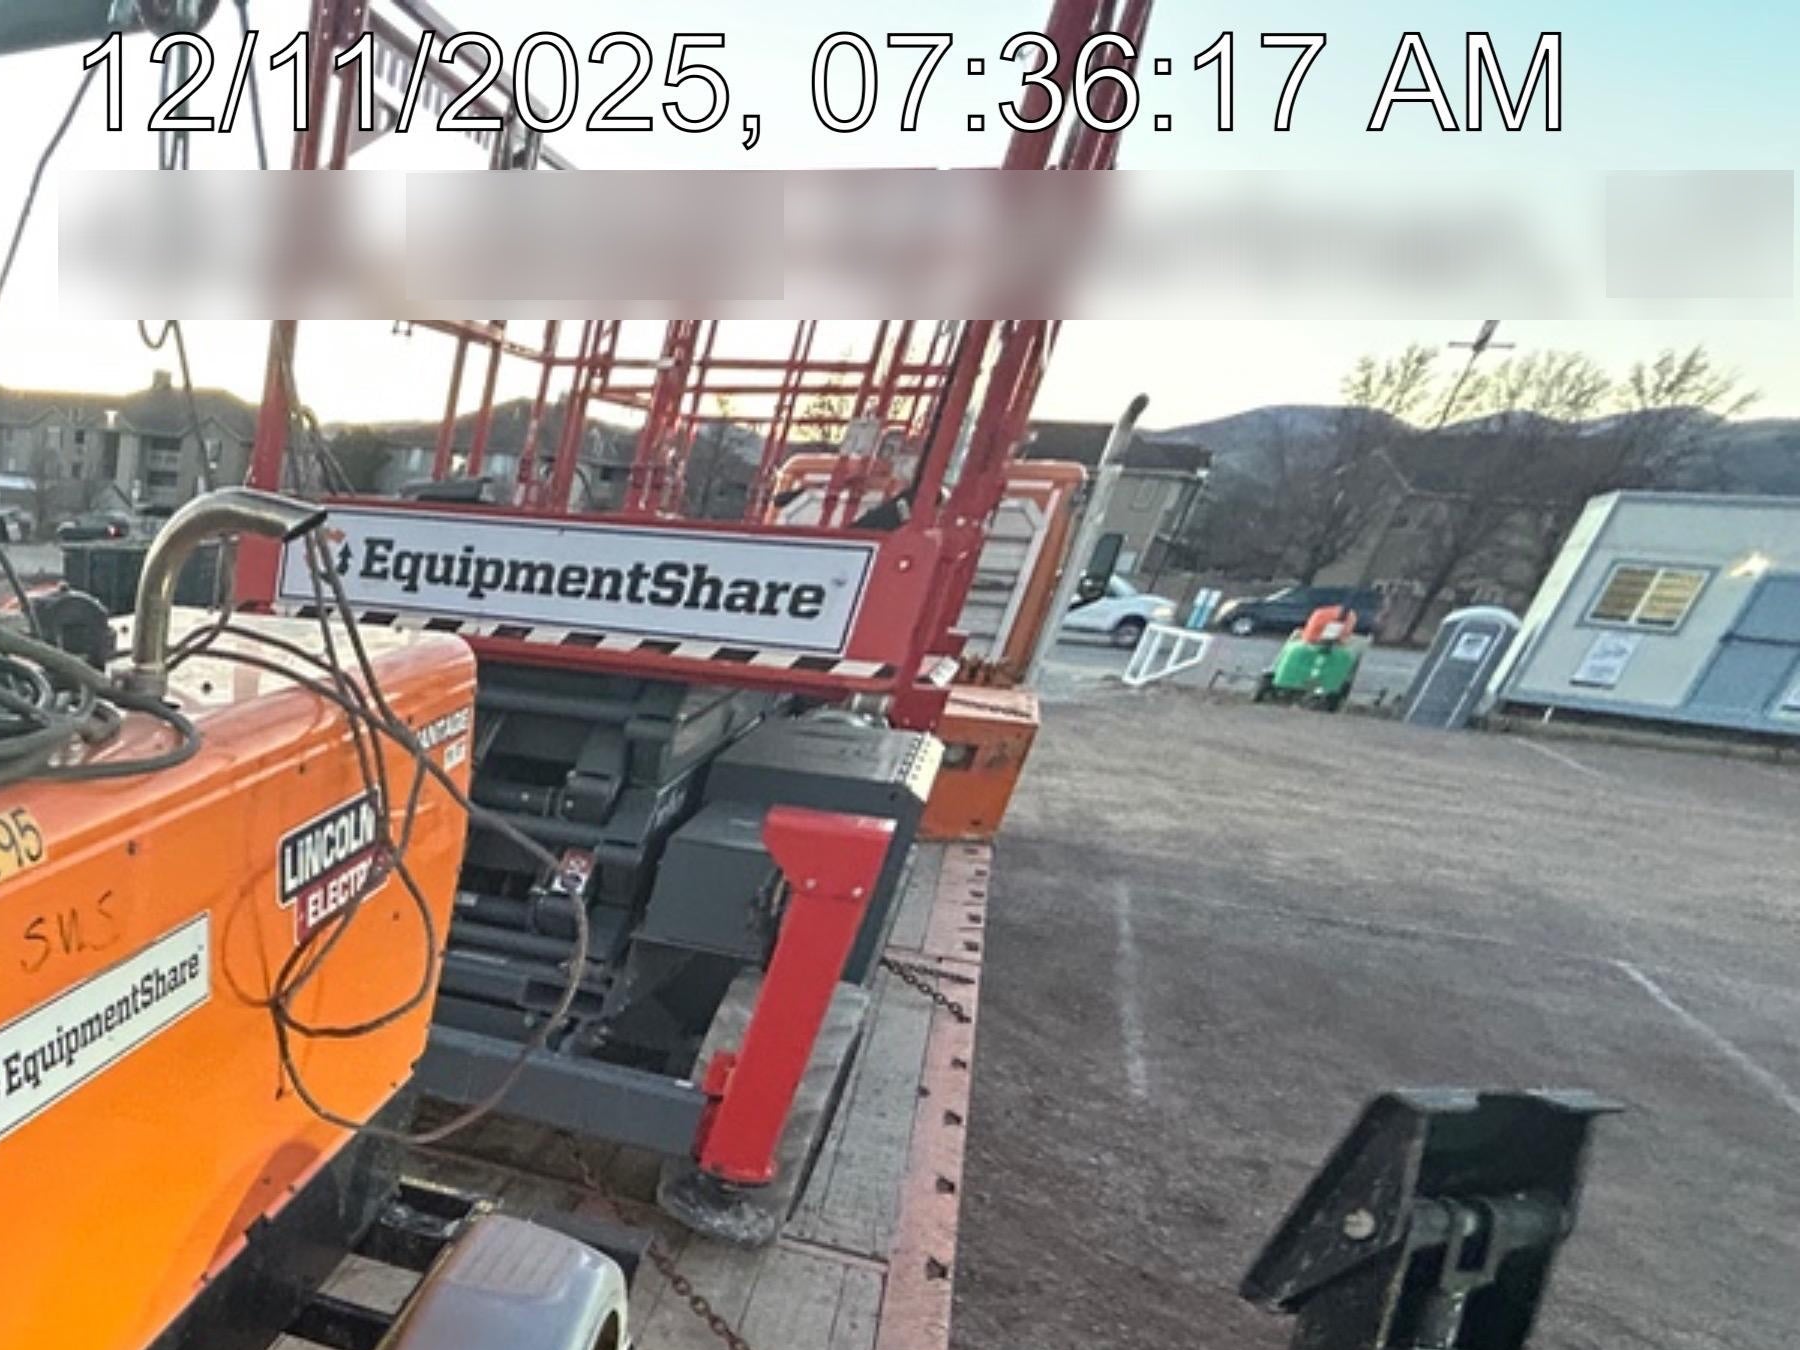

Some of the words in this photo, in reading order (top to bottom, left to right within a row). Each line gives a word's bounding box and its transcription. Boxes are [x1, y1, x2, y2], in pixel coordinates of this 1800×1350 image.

[359, 537, 828, 620] EquipmentShare
[284, 802, 377, 892] LINCOLN
[3, 953, 199, 1096] EquipmentShare
